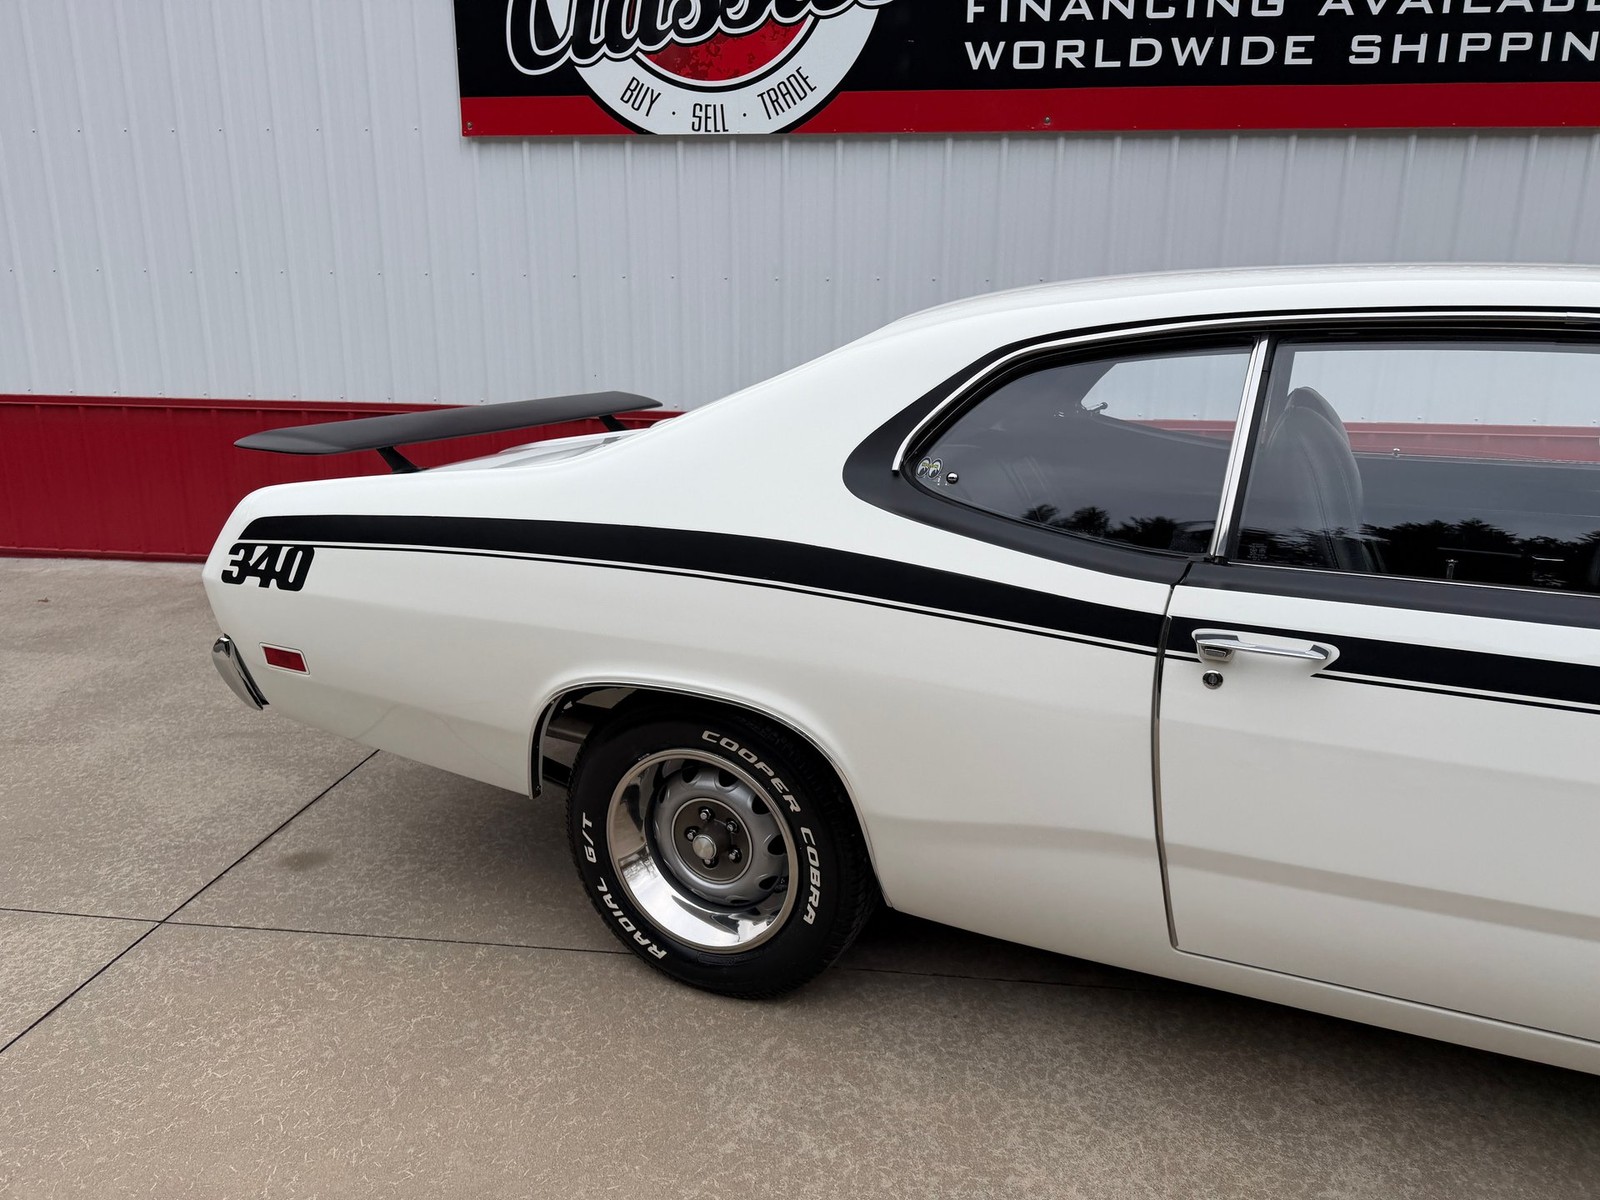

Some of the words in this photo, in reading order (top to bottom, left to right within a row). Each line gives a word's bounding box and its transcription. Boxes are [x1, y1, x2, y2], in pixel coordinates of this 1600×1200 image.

[966, 0, 1285, 23] FINANCING
[964, 35, 1315, 70] WORLDWIDE
[1348, 31, 1600, 65] SHIPPIN
[620, 76, 661, 117] BUY
[691, 103, 729, 133] SELL
[757, 66, 817, 120] TRADE
[221, 542, 315, 592] 340
[582, 812, 597, 864] G/T
[701, 730, 801, 813] COOPER
[800, 826, 821, 925] COBRA
[596, 877, 668, 959] RADIAL
